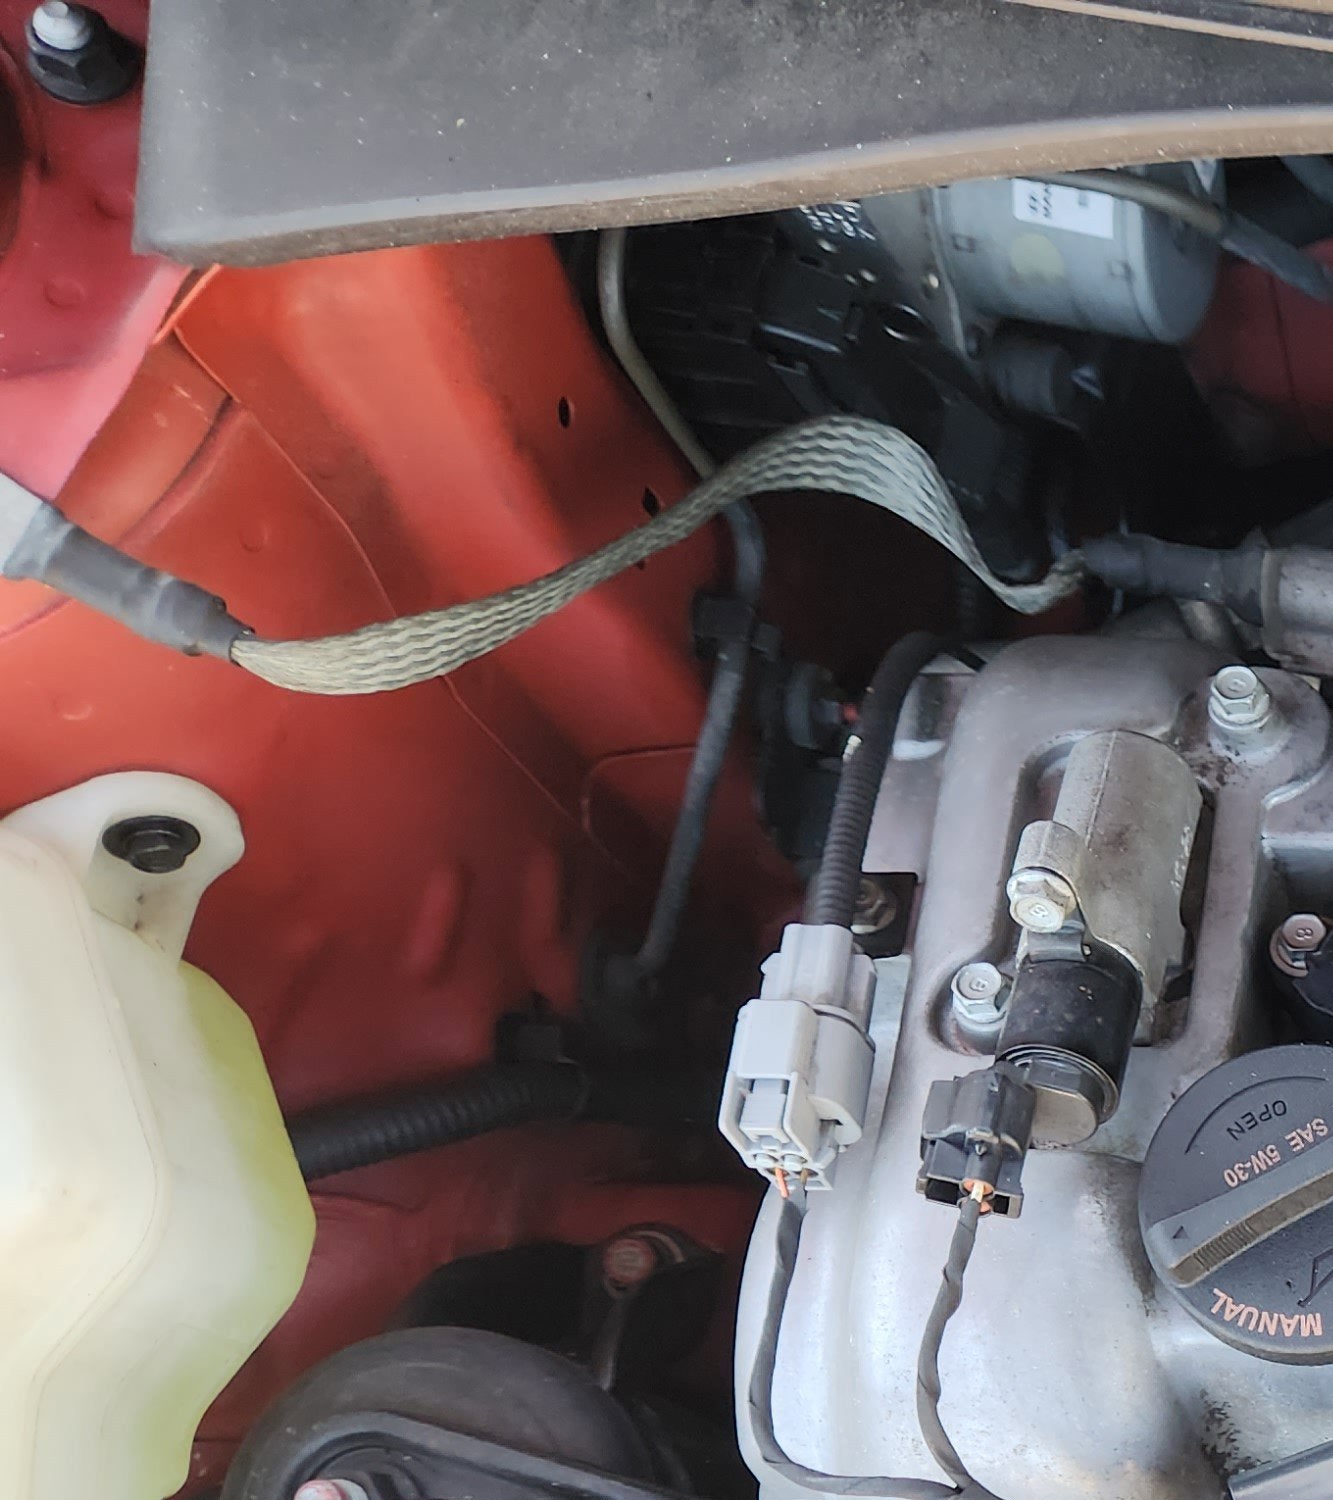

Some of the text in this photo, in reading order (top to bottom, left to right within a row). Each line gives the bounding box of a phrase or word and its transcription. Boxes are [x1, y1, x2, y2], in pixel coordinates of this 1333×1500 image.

[1226, 1099, 1288, 1141] OPEN
[1223, 1117, 1329, 1188] SAE 5W-30
[1211, 1287, 1323, 1337] MANUAL
